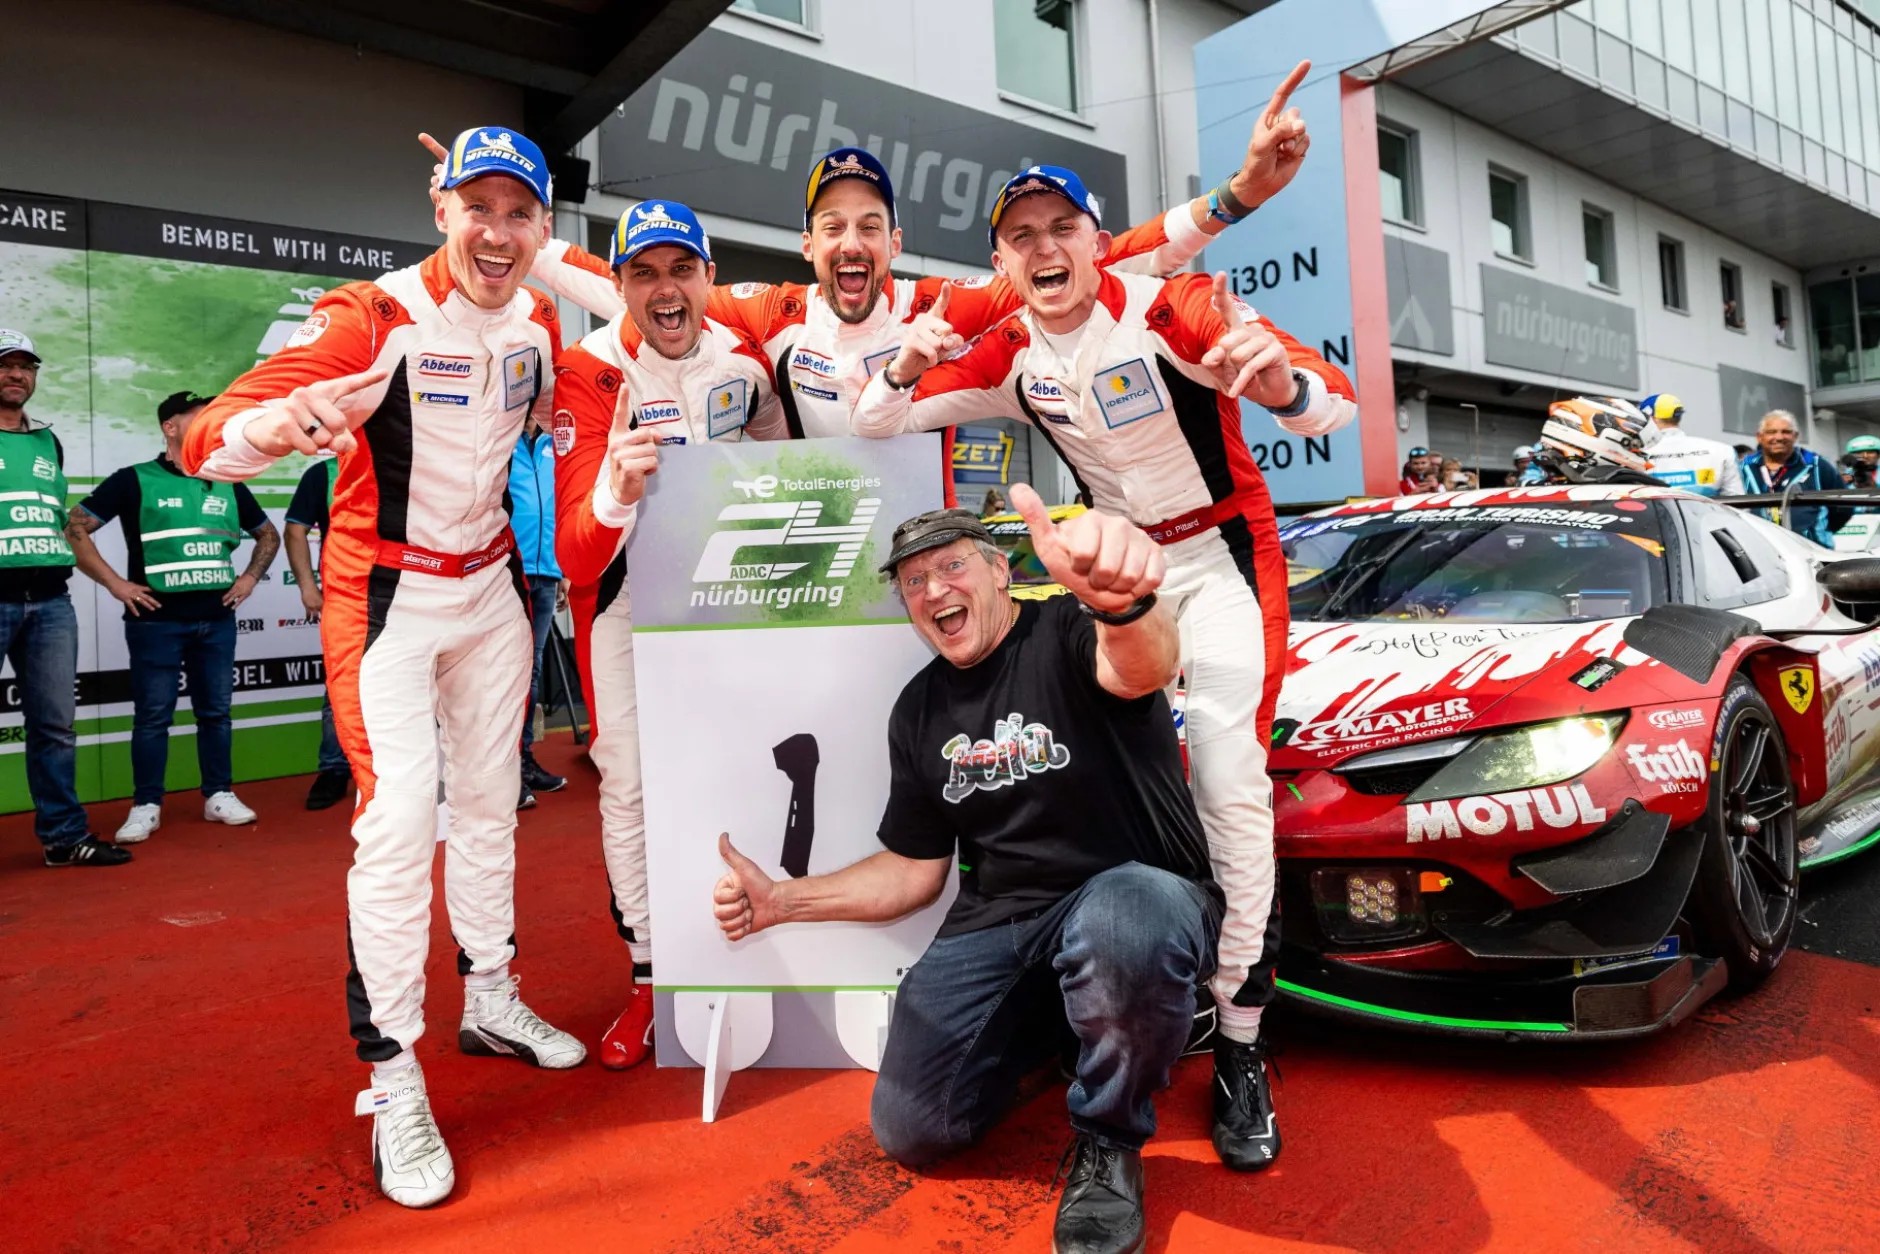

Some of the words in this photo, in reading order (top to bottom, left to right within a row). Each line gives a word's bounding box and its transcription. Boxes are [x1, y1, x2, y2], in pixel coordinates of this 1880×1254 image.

[464, 149, 535, 173] MICHELIN
[819, 168, 879, 185] MICHELIN
[628, 221, 690, 240] MICHELIN
[162, 223, 260, 254] BEMBEL
[273, 237, 326, 262] WITH
[339, 245, 394, 270] CARE
[1232, 260, 1281, 296] i30
[1293, 247, 1319, 282] N
[1497, 294, 1630, 372] nürburgring
[1323, 336, 1350, 366] N
[419, 358, 471, 373] Abbelen
[430, 395, 464, 403] MICHELIN
[1106, 387, 1150, 409] IDENTICA
[952, 443, 1003, 463] ZET
[1246, 440, 1292, 472] 20
[1305, 434, 1331, 466] N
[782, 475, 881, 492] TotalEnergies
[1396, 507, 1479, 519] GRAN
[1477, 507, 1619, 526] TURISMO
[1514, 518, 1603, 530] SIMULATOR
[1165, 529, 1175, 537] D.
[183, 542, 223, 556] GRID
[164, 569, 233, 588] MARSHAL
[730, 566, 767, 580] ADAC
[690, 581, 844, 610] nürburgring
[285, 660, 323, 682] WIT
[1341, 697, 1471, 739] MAYER
[1394, 712, 1475, 734] MOTORSPORT
[1665, 709, 1702, 724] MAYER
[1715, 685, 1748, 739] MICHELIN
[1317, 742, 1371, 758] ELECTRIC
[1375, 735, 1401, 747] FOR
[1404, 726, 1454, 742] RACING
[1625, 738, 1707, 784] früh
[1660, 781, 1698, 794] KÖLSCH
[772, 733, 820, 878] 1
[1406, 784, 1607, 844] MOTUL
[390, 1085, 417, 1101] NICK
